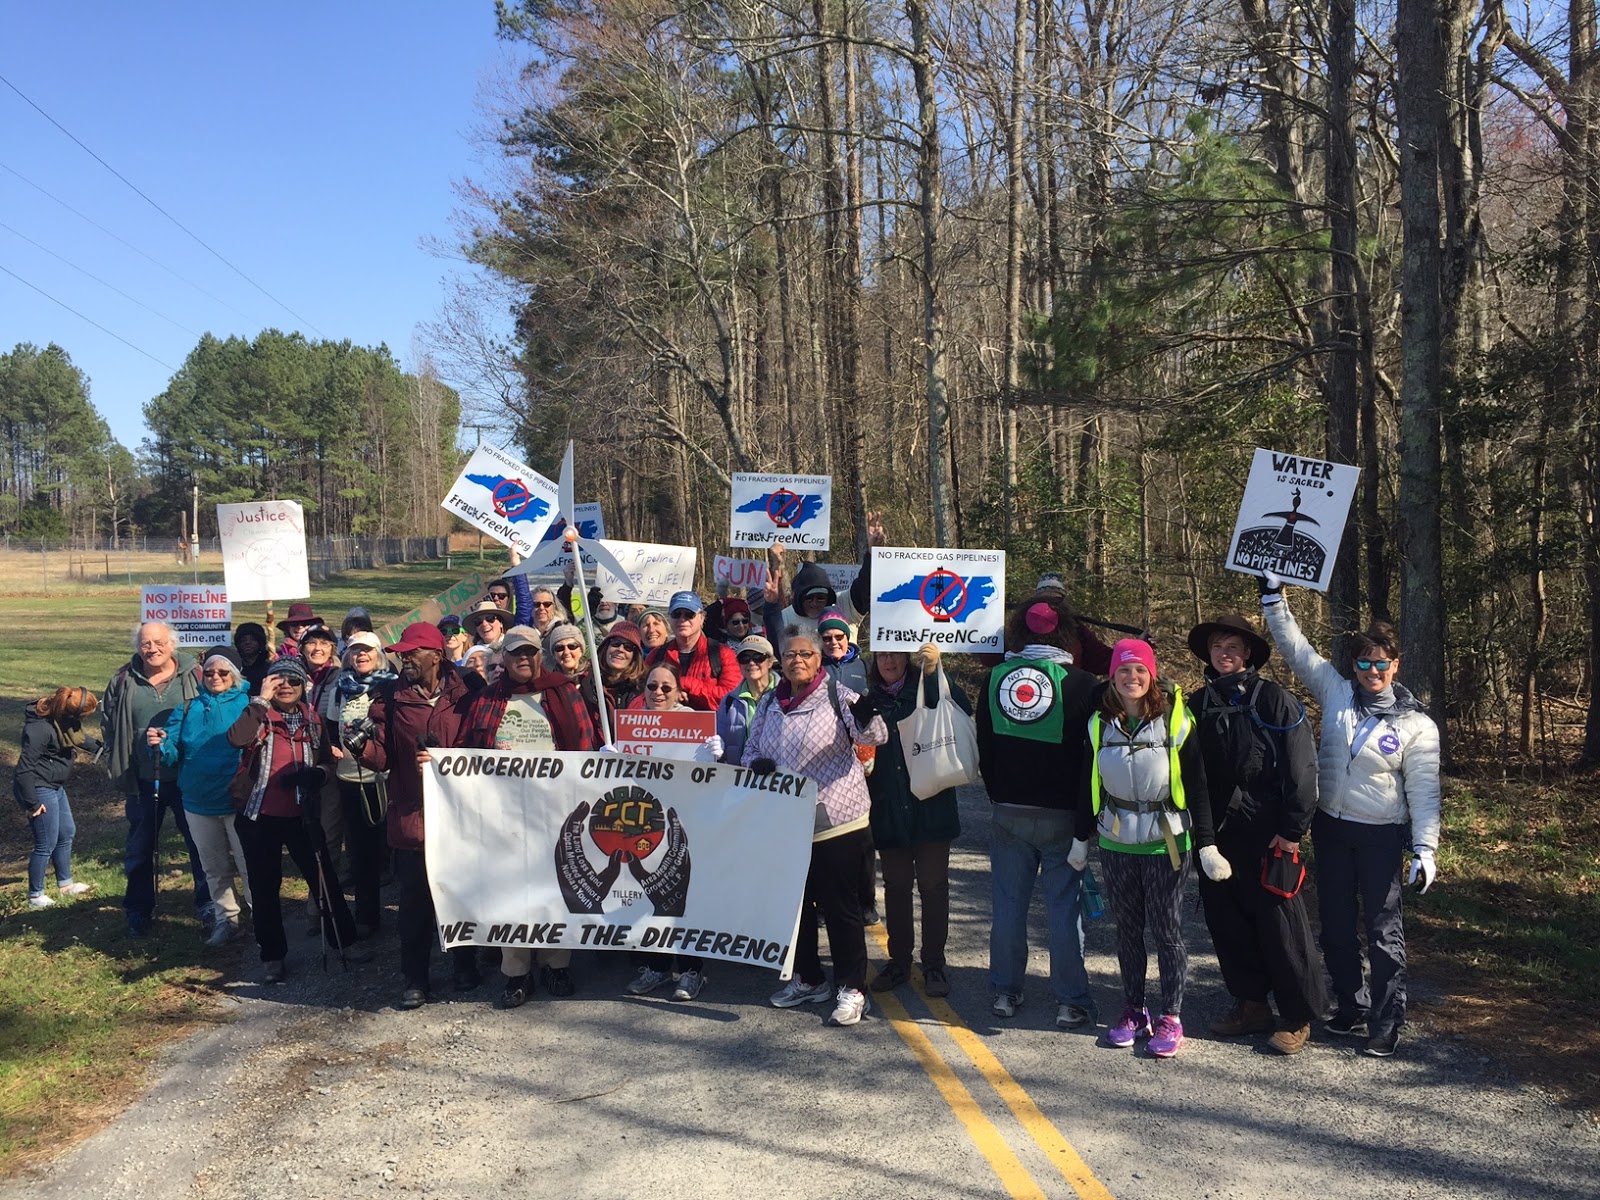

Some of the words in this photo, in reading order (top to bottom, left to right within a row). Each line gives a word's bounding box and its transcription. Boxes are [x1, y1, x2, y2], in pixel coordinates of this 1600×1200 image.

[483, 446, 493, 455] NO
[492, 451, 521, 472] FRACKED
[520, 468, 533, 479] GAS
[533, 476, 559, 495] PIPELINE
[1272, 454, 1334, 480] WATER
[794, 477, 827, 485] PIPELINES!
[1277, 475, 1287, 483] IS
[236, 506, 286, 524] Justice
[448, 493, 532, 552] FrackFreeNCorg
[734, 529, 825, 546] FrackFreeNC.org
[612, 549, 625, 563] O
[634, 549, 683, 569] Pipeline!
[878, 551, 892, 559] NO
[894, 552, 934, 560] FRACKED
[936, 553, 954, 561] GAS
[956, 553, 1000, 562] PIPELINES!
[1235, 551, 1250, 563] NO
[1251, 555, 1317, 580] PIPELINES
[605, 572, 643, 585] WER
[658, 571, 687, 589] LIFE!
[717, 558, 764, 587] SUN
[145, 593, 167, 604] NO
[170, 589, 228, 604] PIPELINE
[436, 571, 481, 616] JOBS?
[647, 589, 670, 600] ACP
[146, 609, 168, 620] NO
[171, 605, 226, 619] DISASTER
[179, 633, 226, 643] eline.net
[876, 627, 999, 647] FrackFreeNC.org
[1007, 669, 1024, 682] NOT
[1035, 674, 1050, 690] ONE
[619, 714, 662, 726] THINK
[632, 728, 713, 740] GLOBALLY...
[622, 744, 653, 756] ACT
[438, 755, 564, 779] CONCERNED
[580, 758, 675, 781] CITIZENS
[691, 767, 717, 784] OF
[734, 768, 807, 797] TILLERY
[604, 801, 653, 826] CCT
[573, 820, 581, 833] The
[563, 831, 573, 851] Open
[573, 835, 581, 853] Land
[640, 873, 658, 887] Area
[655, 856, 673, 876] Health
[668, 817, 680, 858] Committee
[566, 852, 581, 878] Minded
[576, 854, 589, 872] Loss
[644, 877, 667, 895] Grown
[664, 865, 678, 880] Folk
[674, 843, 687, 866] Group
[561, 864, 578, 890] Nubian
[576, 889, 593, 910] Youth
[586, 869, 603, 888] Fund
[578, 877, 601, 902] Seniors
[612, 890, 643, 899] TILLERY
[440, 921, 477, 944] WE
[486, 922, 567, 944] MAKE
[580, 924, 631, 946] THE
